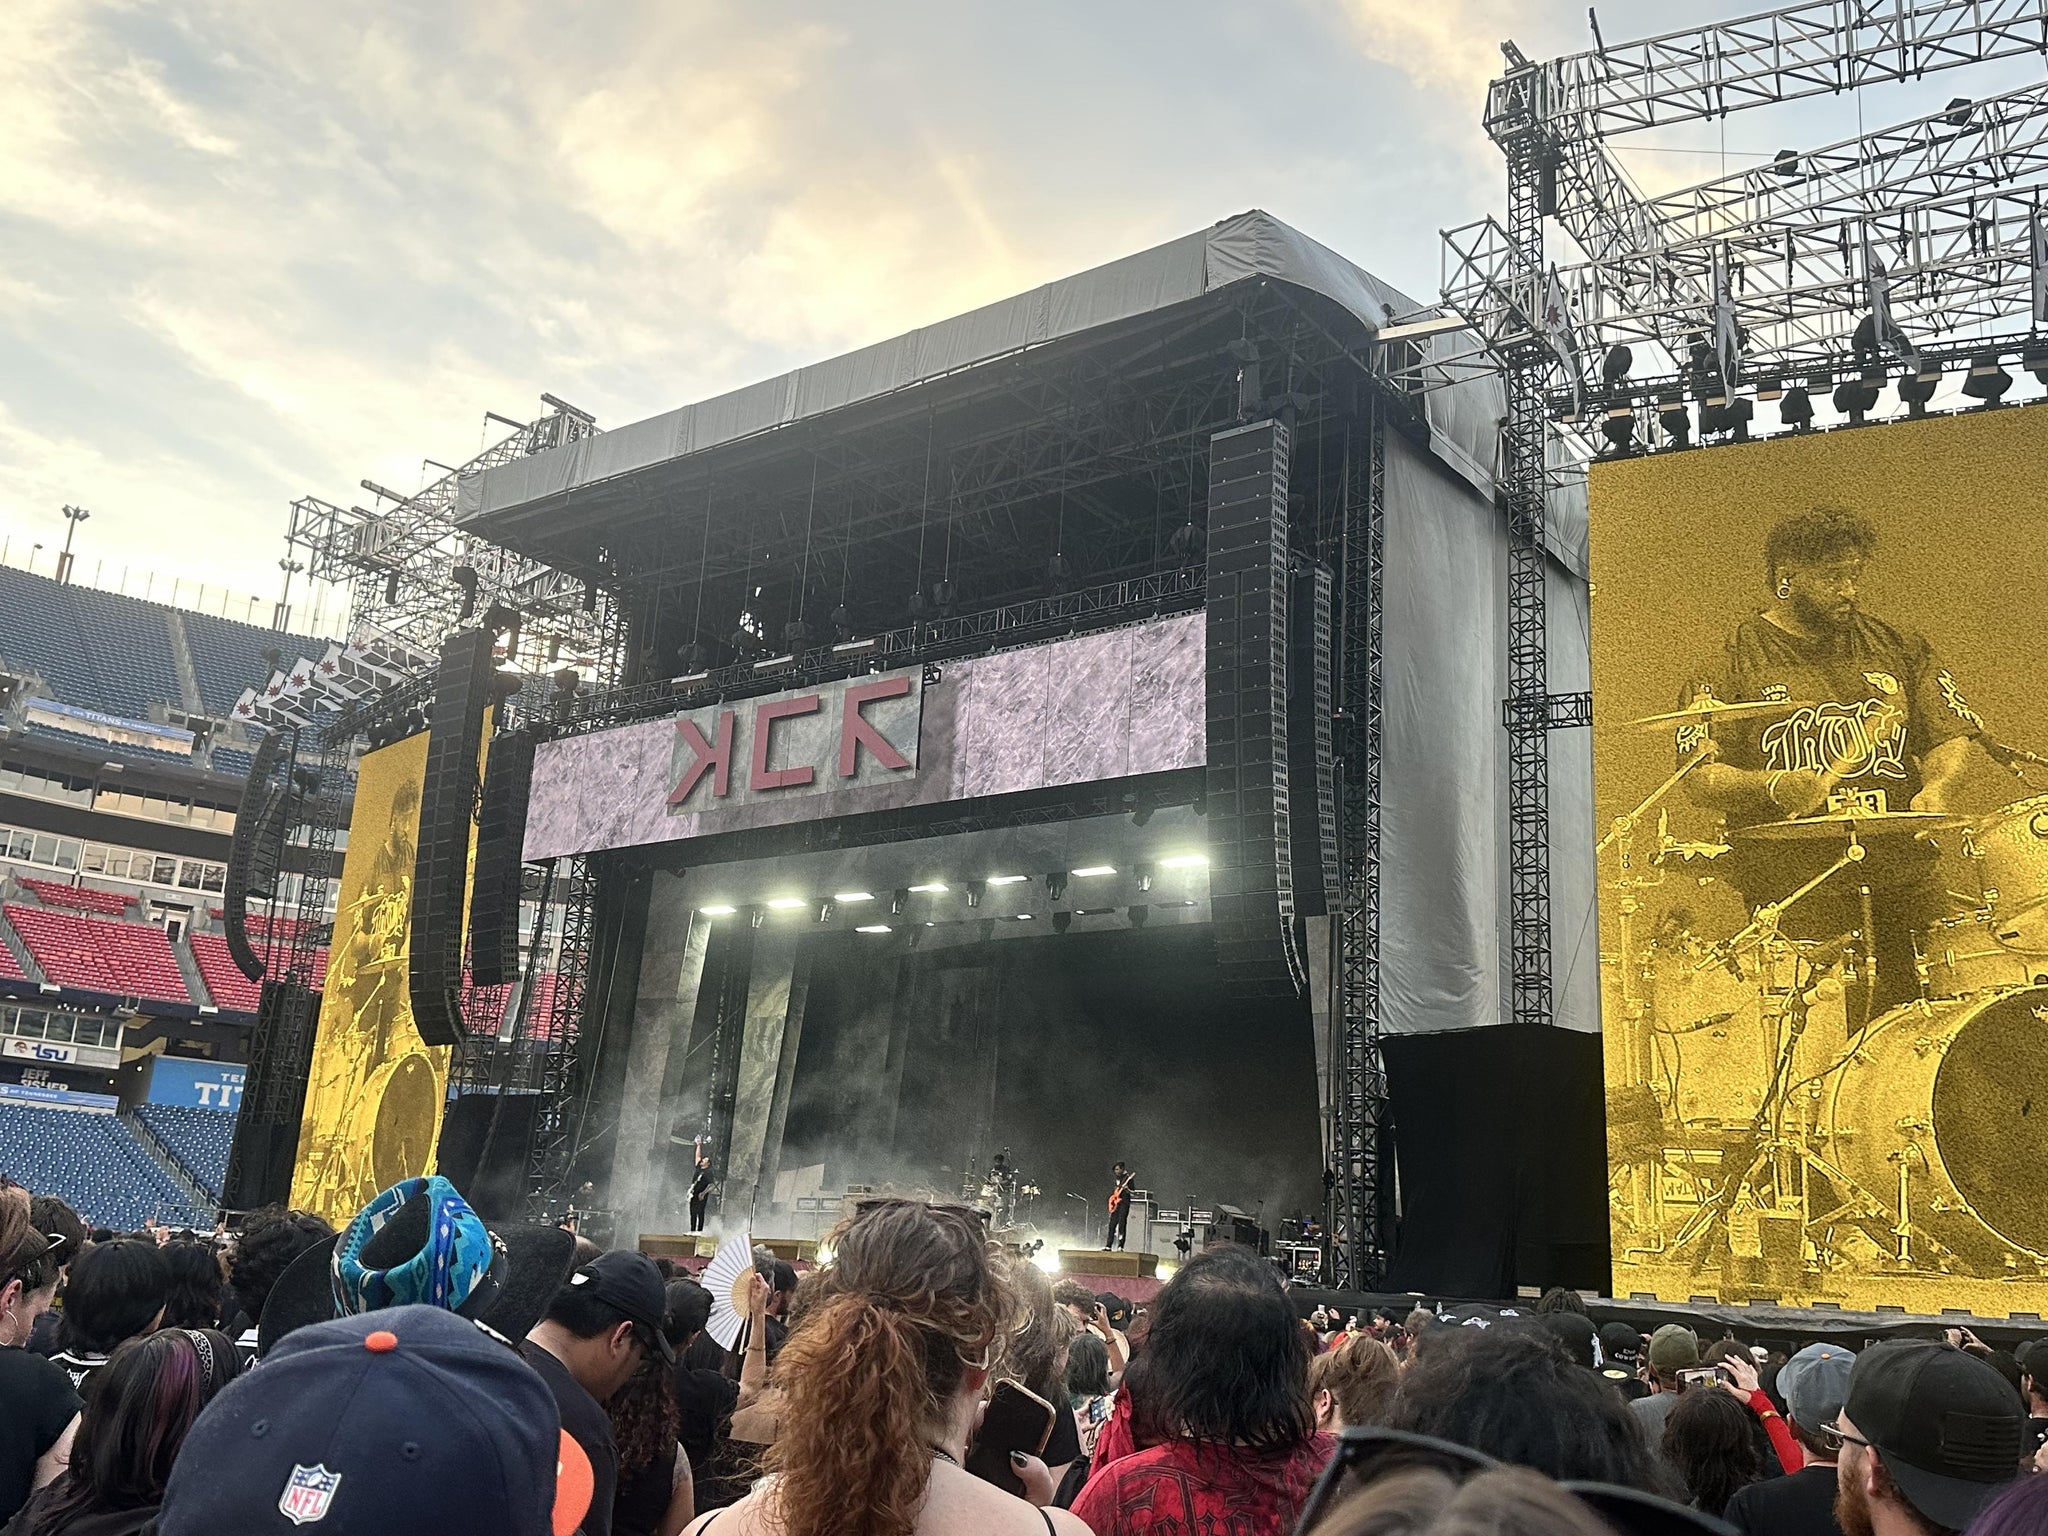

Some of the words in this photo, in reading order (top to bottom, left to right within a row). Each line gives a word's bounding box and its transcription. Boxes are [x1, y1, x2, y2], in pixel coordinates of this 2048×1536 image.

[85, 711, 121, 725] TITANS
[21, 1068, 51, 1081] JEFF
[286, 1486, 323, 1516] NFL
